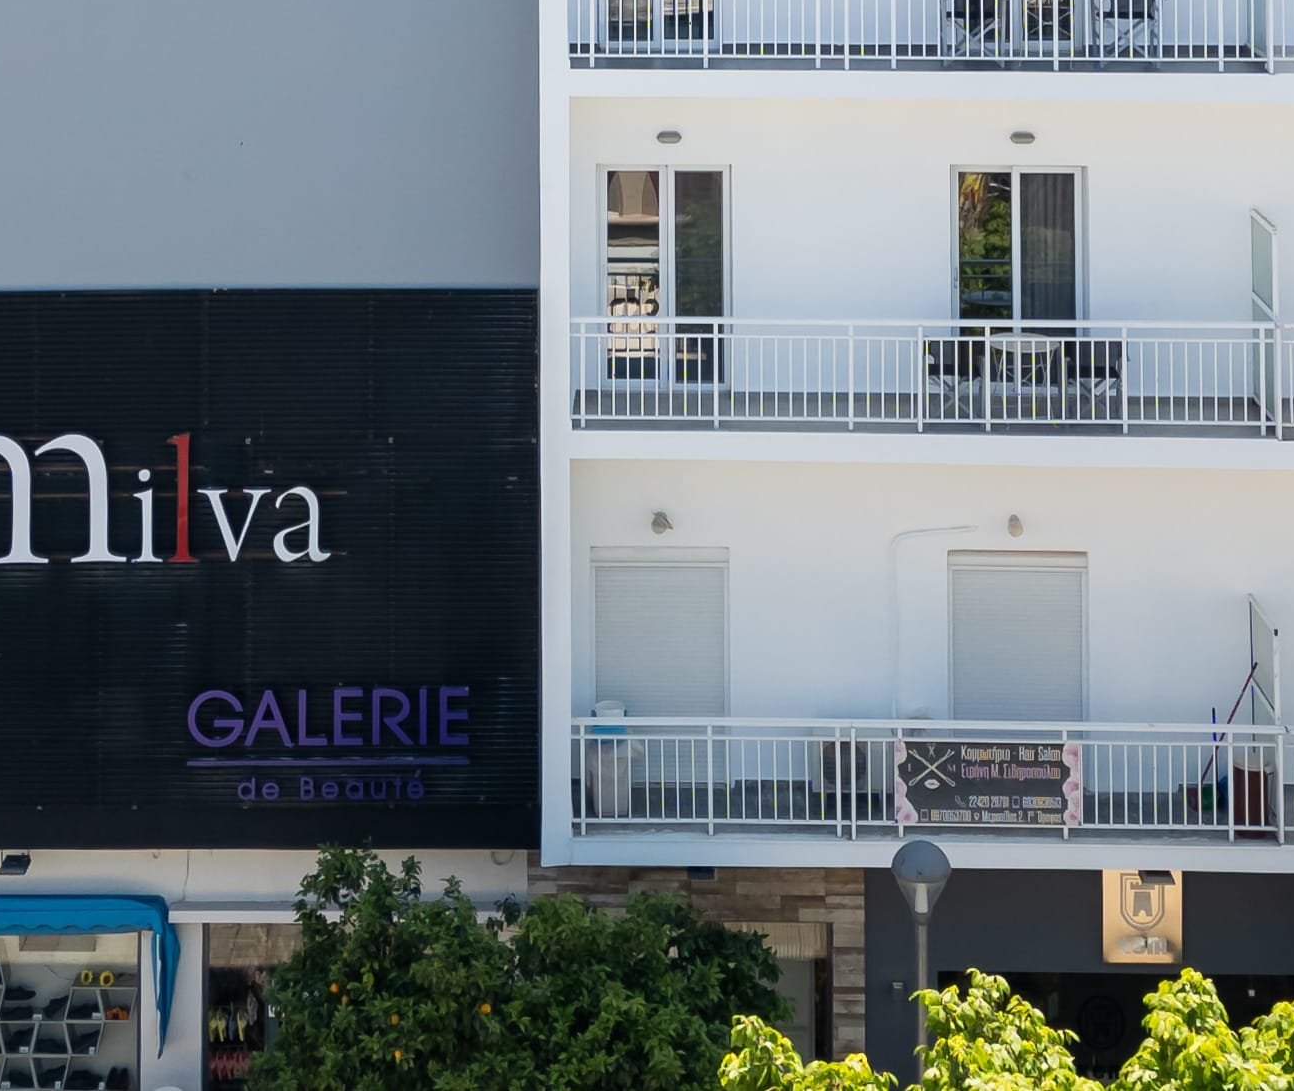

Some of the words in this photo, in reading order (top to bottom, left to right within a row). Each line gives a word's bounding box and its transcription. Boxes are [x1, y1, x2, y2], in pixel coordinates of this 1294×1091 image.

[187, 686, 469, 748] GALERIE
[1018, 746, 1035, 761] Hair
[237, 777, 280, 801] de
[299, 769, 425, 801] Beauté
